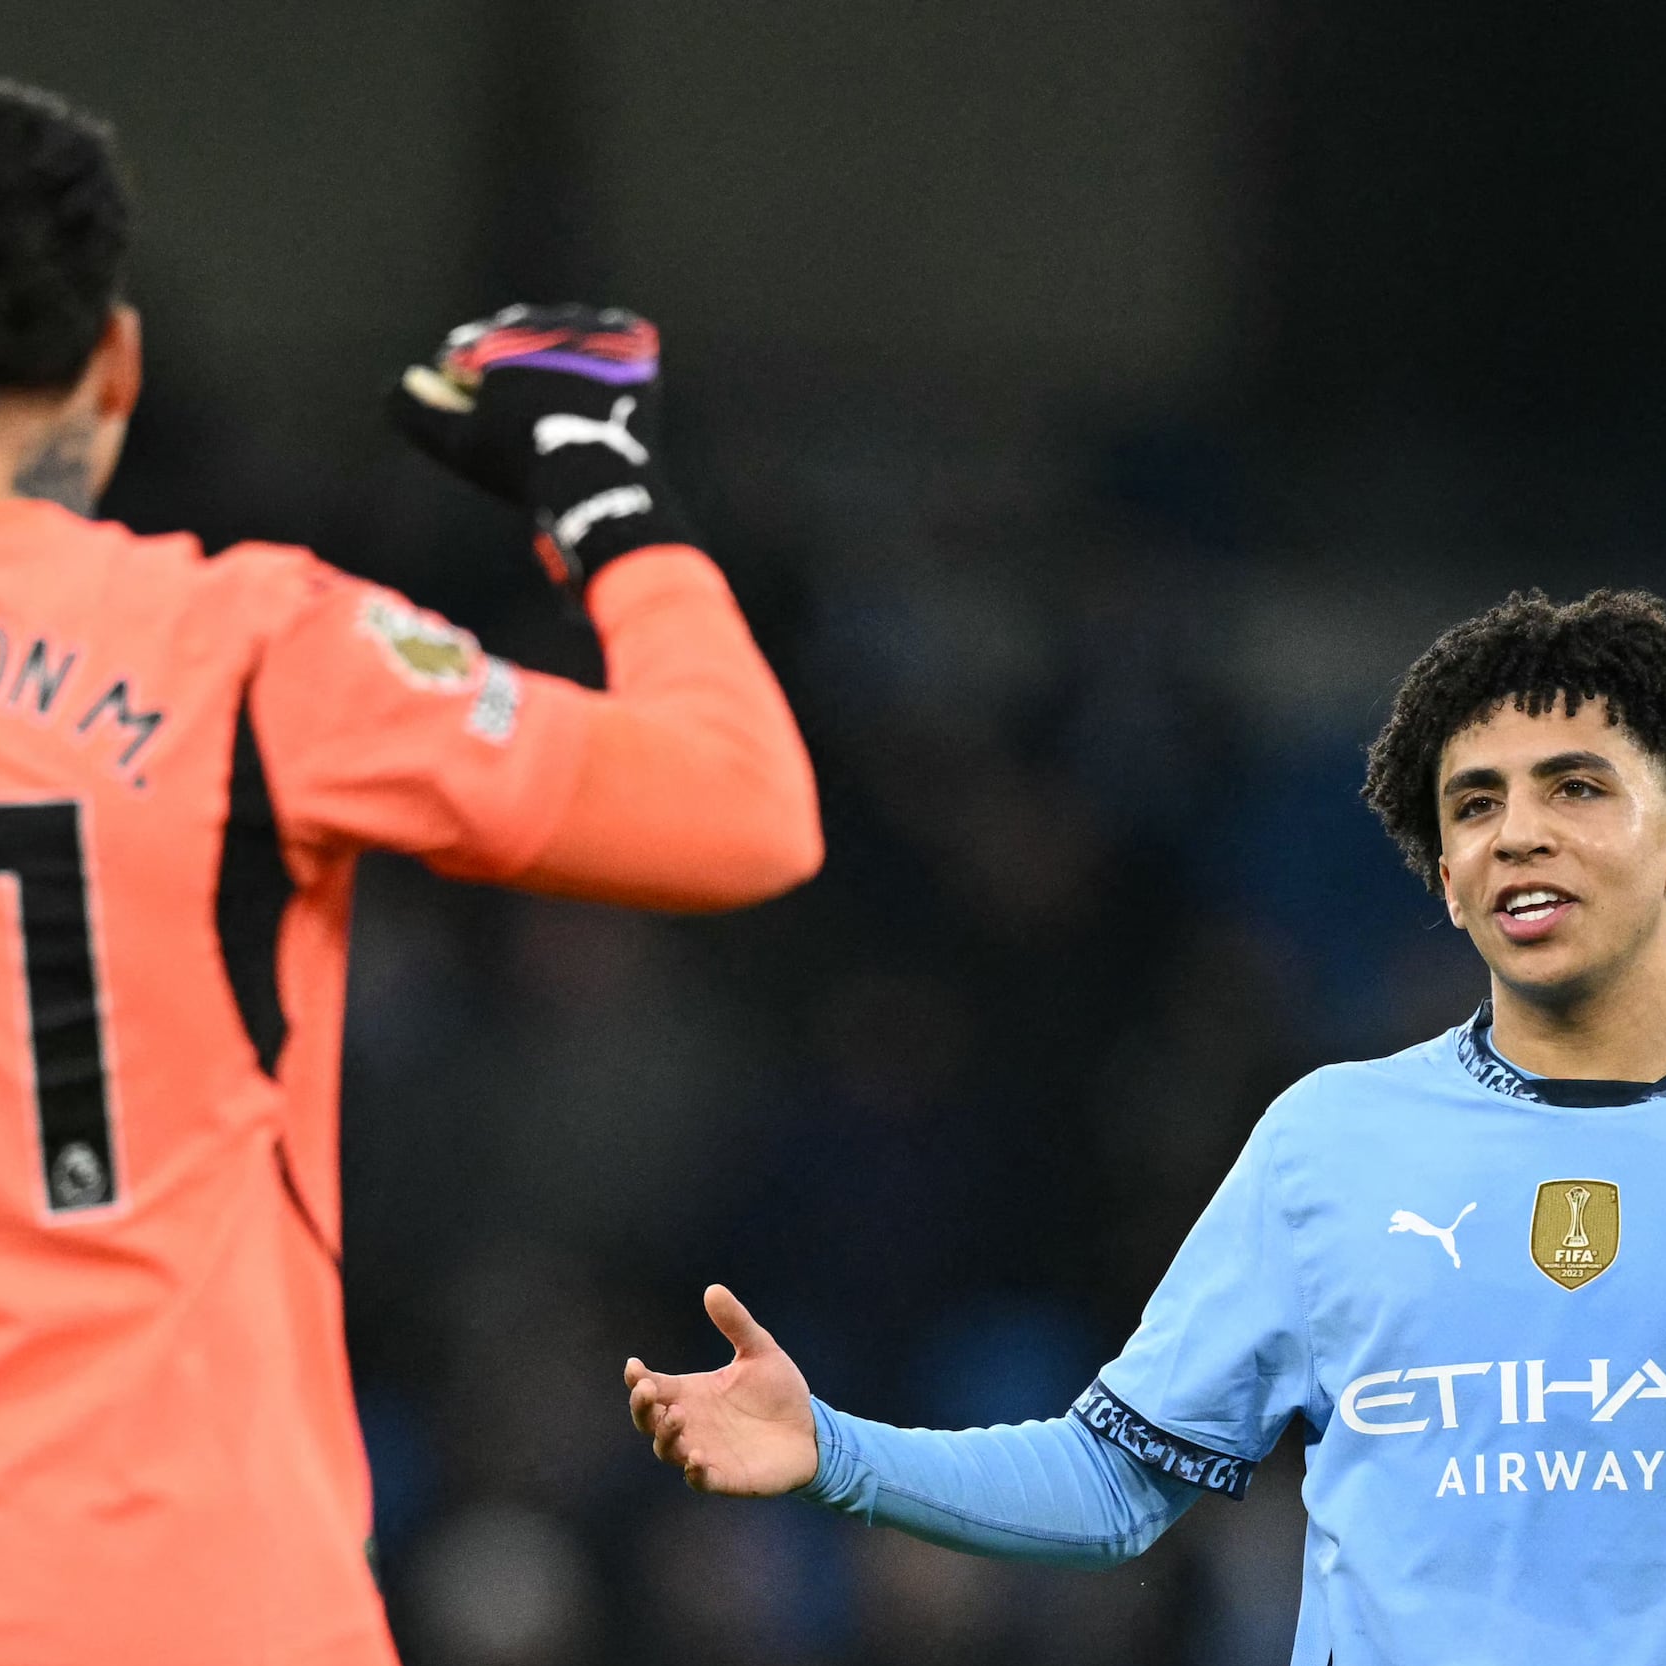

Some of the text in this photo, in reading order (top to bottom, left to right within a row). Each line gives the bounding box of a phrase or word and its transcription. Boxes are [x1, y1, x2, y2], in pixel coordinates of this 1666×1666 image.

[77, 680, 166, 790] M.
[1554, 1249, 1595, 1263] FIFA
[1561, 1269, 1584, 1278] 2023
